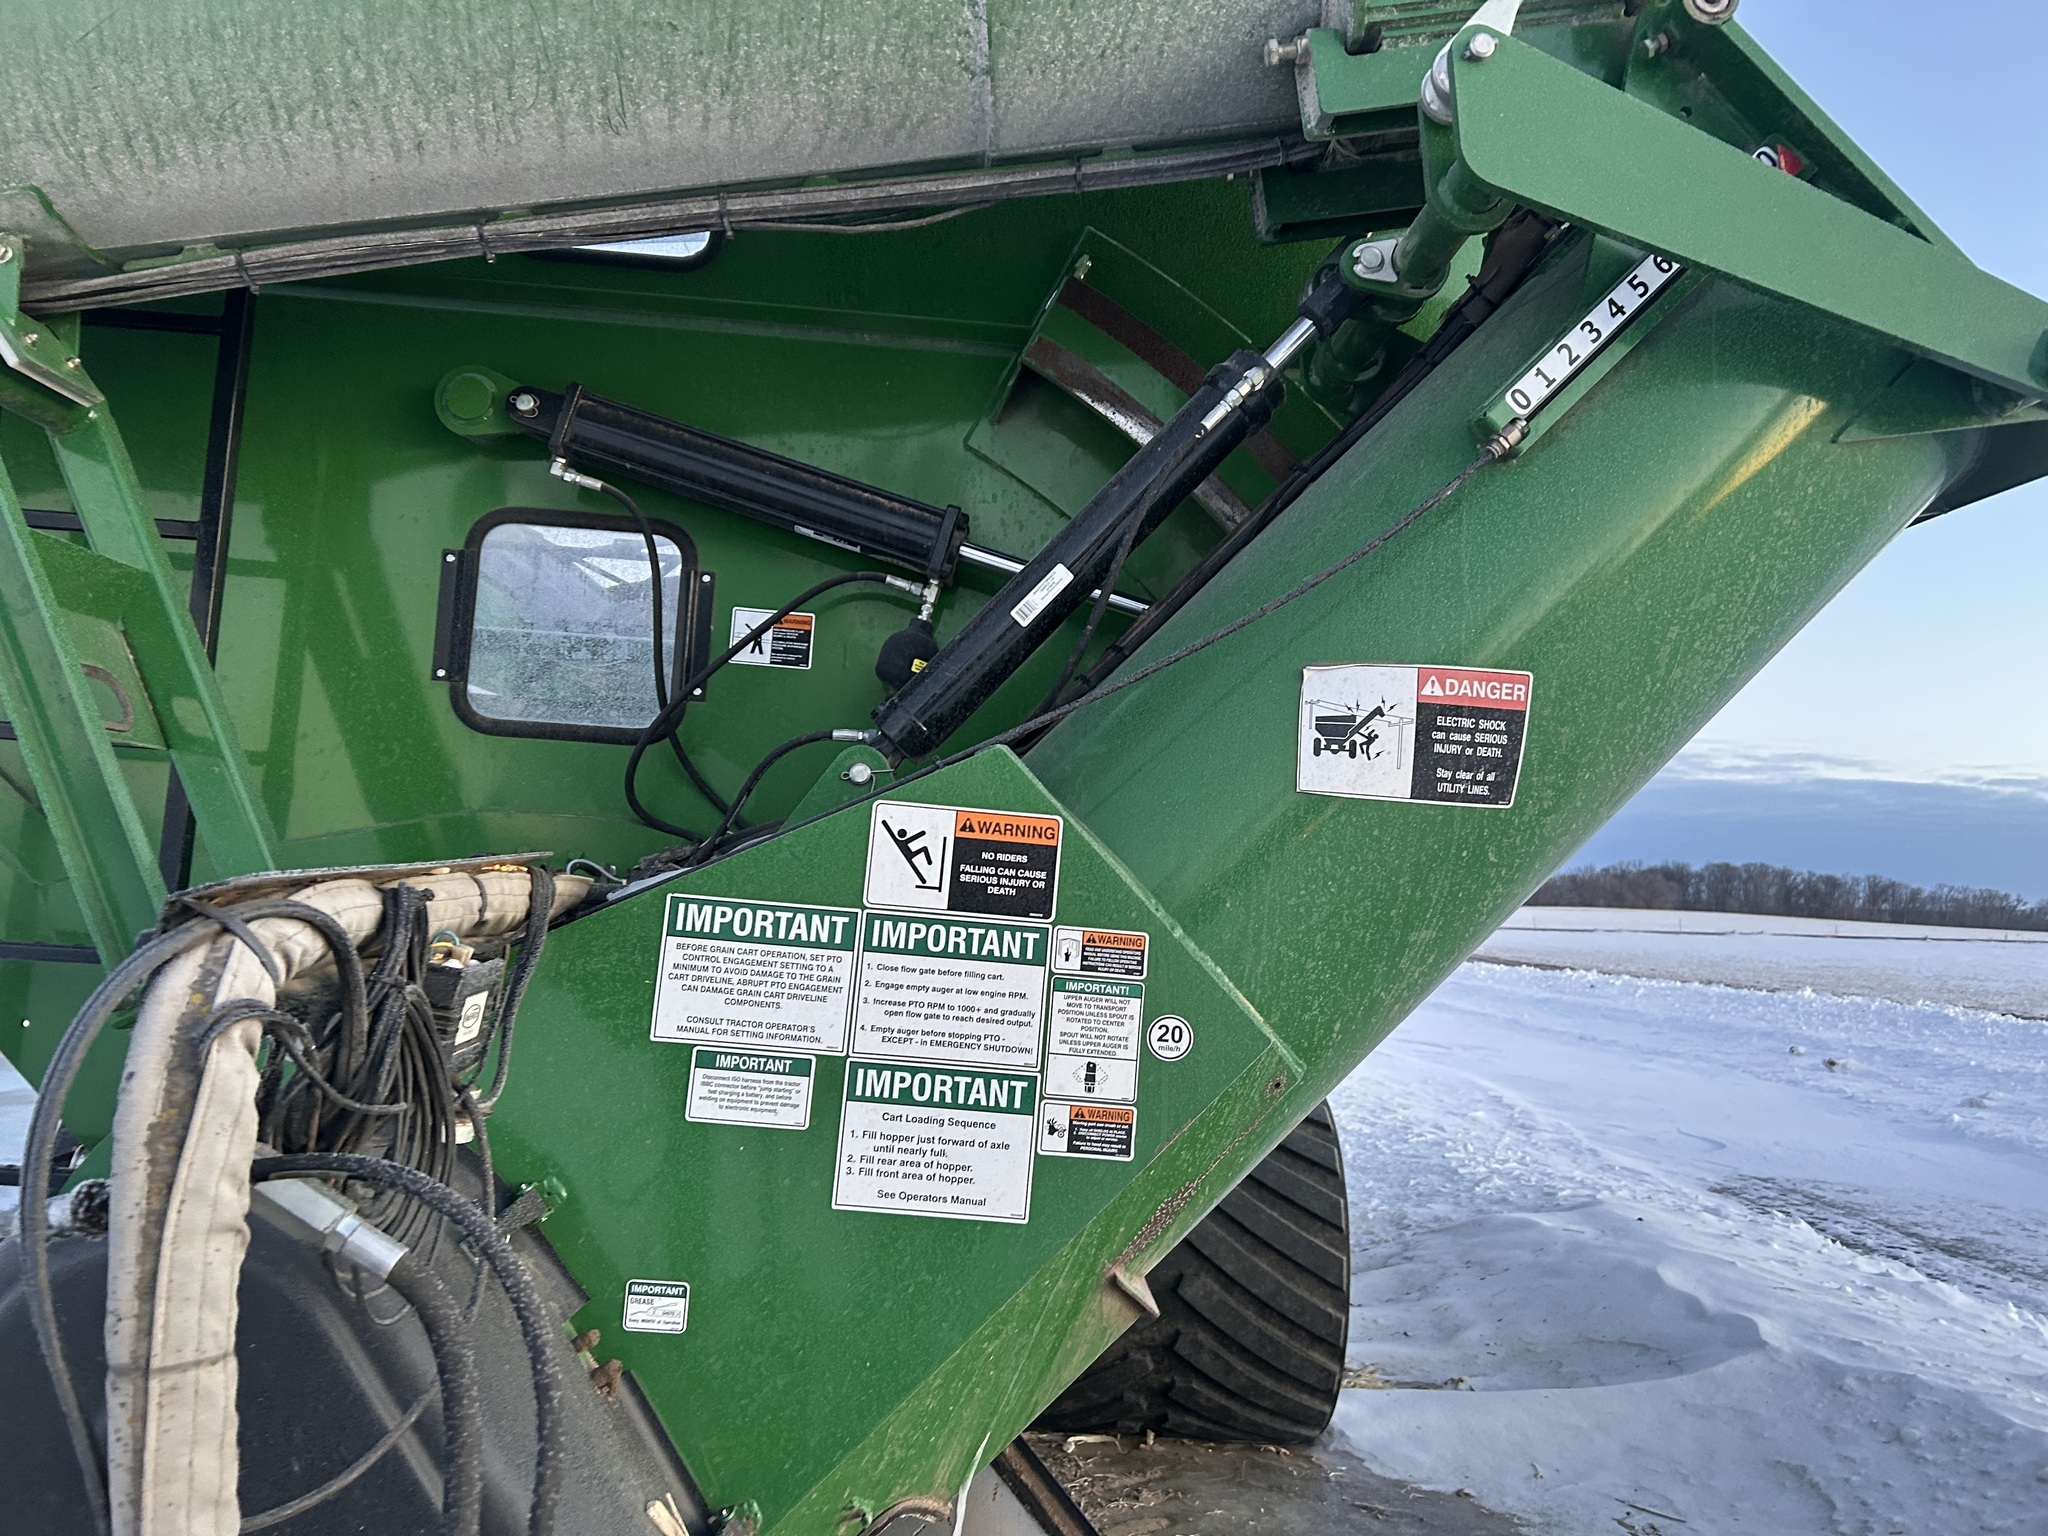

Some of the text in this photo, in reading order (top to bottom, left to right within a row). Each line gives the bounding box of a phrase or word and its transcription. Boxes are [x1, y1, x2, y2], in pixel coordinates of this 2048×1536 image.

[1510, 255, 1673, 410] 0 1 2 3 4 5 6
[1444, 678, 1526, 701] DANGER
[1436, 715, 1506, 731] ELECTRIC SHOCK
[1431, 730, 1508, 745] can cause SERIOUS
[1433, 742, 1503, 758] INJURY or DEATH.
[1435, 767, 1496, 781] Stay clear of all
[1436, 782, 1490, 795] UTILITY LINES.
[977, 820, 1055, 840] WARNING
[981, 851, 1028, 863] NO RIDERS
[959, 863, 1047, 879] FALLING CAN CAUSE
[959, 873, 1045, 889] SERIOUS INJURY OR
[987, 886, 1016, 896] DEATH
[675, 902, 849, 944] IMPORTANT
[871, 919, 1040, 959] IMPORTANT
[1097, 934, 1142, 948] WARNING
[675, 942, 842, 964] BEFORE GRAIN CART OPERATION, SET PTO
[682, 952, 834, 973] CONTROL ENGAGEMENT SETTING TO A
[866, 962, 873, 970] 1.
[876, 963, 899, 972] Close
[900, 965, 917, 973] flow
[918, 967, 936, 976] gate
[937, 968, 962, 977] before
[964, 970, 986, 981] filling
[672, 962, 841, 983] MINIMUM TO AVOID DAMAGE TO THE GRAIN
[667, 972, 844, 994] CART DRIVELINE, ABRUPT PTO ENGAGEMENT
[864, 979, 871, 987] 2.
[874, 980, 904, 991] Engage
[905, 984, 930, 993] empty
[931, 986, 954, 995] auger
[964, 987, 978, 996] low
[980, 990, 1006, 999] engine
[1007, 991, 1028, 1000] RPM.
[1065, 981, 1129, 995] IMPORTANT!
[680, 983, 828, 1003] CAN DAMAGE GRAIN CART DRIVELINE
[1083, 995, 1103, 1003] AUGER
[724, 997, 782, 1010] COMPONENTS.
[862, 996, 870, 1004] 3.
[872, 997, 906, 1007] Increase
[907, 1000, 925, 1008] PTO
[926, 1001, 945, 1010] RPM
[946, 1003, 955, 1011] to
[957, 1004, 981, 1013] 1000+
[1000, 1008, 1036, 1019] gradually
[1066, 1001, 1127, 1012] MOVE TO TRANSPORT
[686, 1015, 815, 1033] CONSULT TRACTOR OPERATOR'S
[883, 1009, 904, 1018] open
[905, 1010, 922, 1018] flow
[923, 1012, 941, 1020] gate
[975, 1015, 1005, 1025] desired
[1006, 1019, 1033, 1028] output.
[676, 1024, 823, 1044] MANUAL FOR SETTING INFORMATION.
[1080, 1025, 1109, 1033] POSITION.
[1156, 1024, 1183, 1043] 20
[1068, 1046, 1086, 1054] FULLY
[1157, 1044, 1181, 1052] mile/h
[715, 1054, 792, 1073] IMPORTANT
[855, 1068, 1028, 1109] IMPORTANT
[881, 1111, 996, 1130] Cart Loading Sequence
[1087, 1108, 1130, 1122] WARNING
[850, 1129, 1010, 1150] 1. Fill hopper just forward of axle
[873, 1144, 948, 1158] until nearly full.
[846, 1153, 973, 1173] 2. Fill rear area of hopper.
[845, 1166, 975, 1185] 3. Fill front area of hopper.
[876, 1189, 986, 1206] See Operators Manual
[631, 1285, 684, 1295] IMPORTANT
[630, 1297, 654, 1305] GREASE
